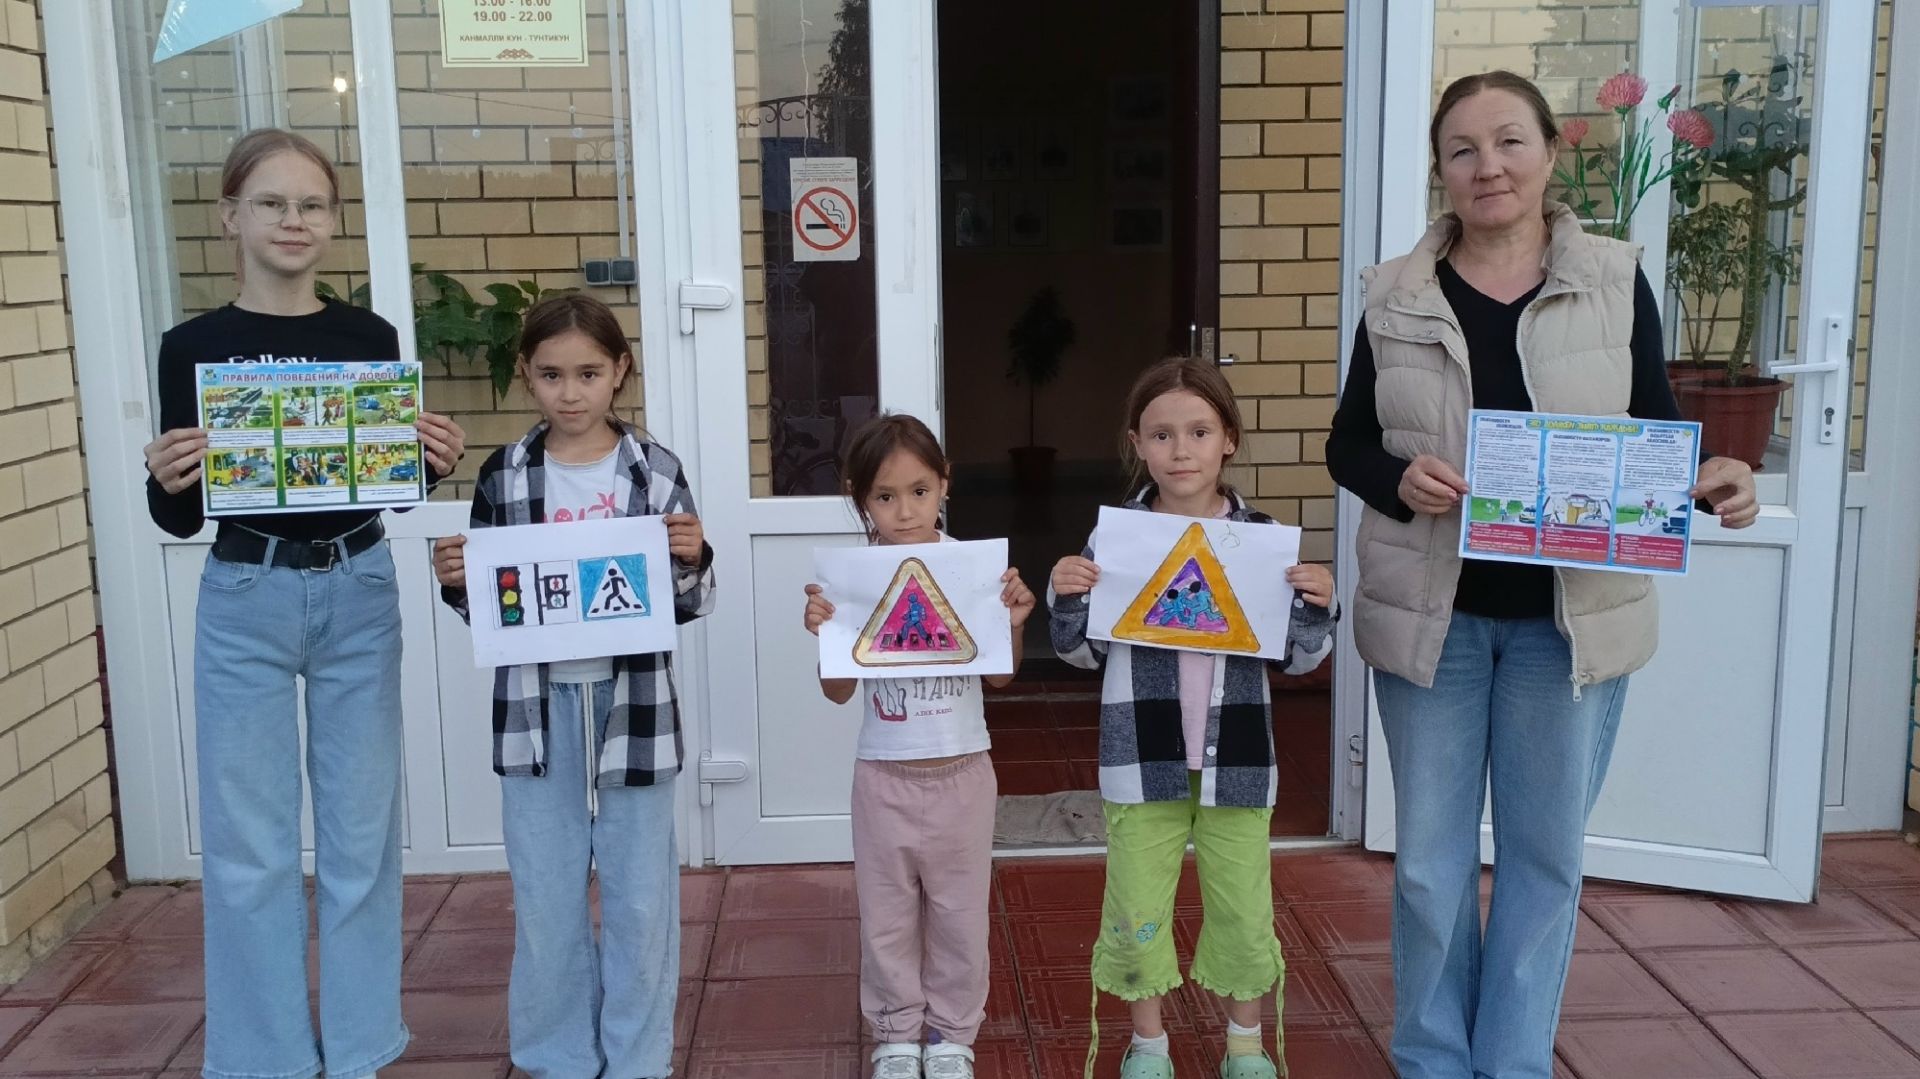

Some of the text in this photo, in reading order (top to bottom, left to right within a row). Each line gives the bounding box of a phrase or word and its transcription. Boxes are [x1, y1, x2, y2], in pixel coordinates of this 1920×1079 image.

[473, 11, 507, 22] 19.00
[519, 11, 553, 22] 22.00
[506, 34, 522, 42] КУН
[222, 371, 399, 382] ПРАВИЛА ПОВЕДЕНИЯ НА ДОРОГЕ
